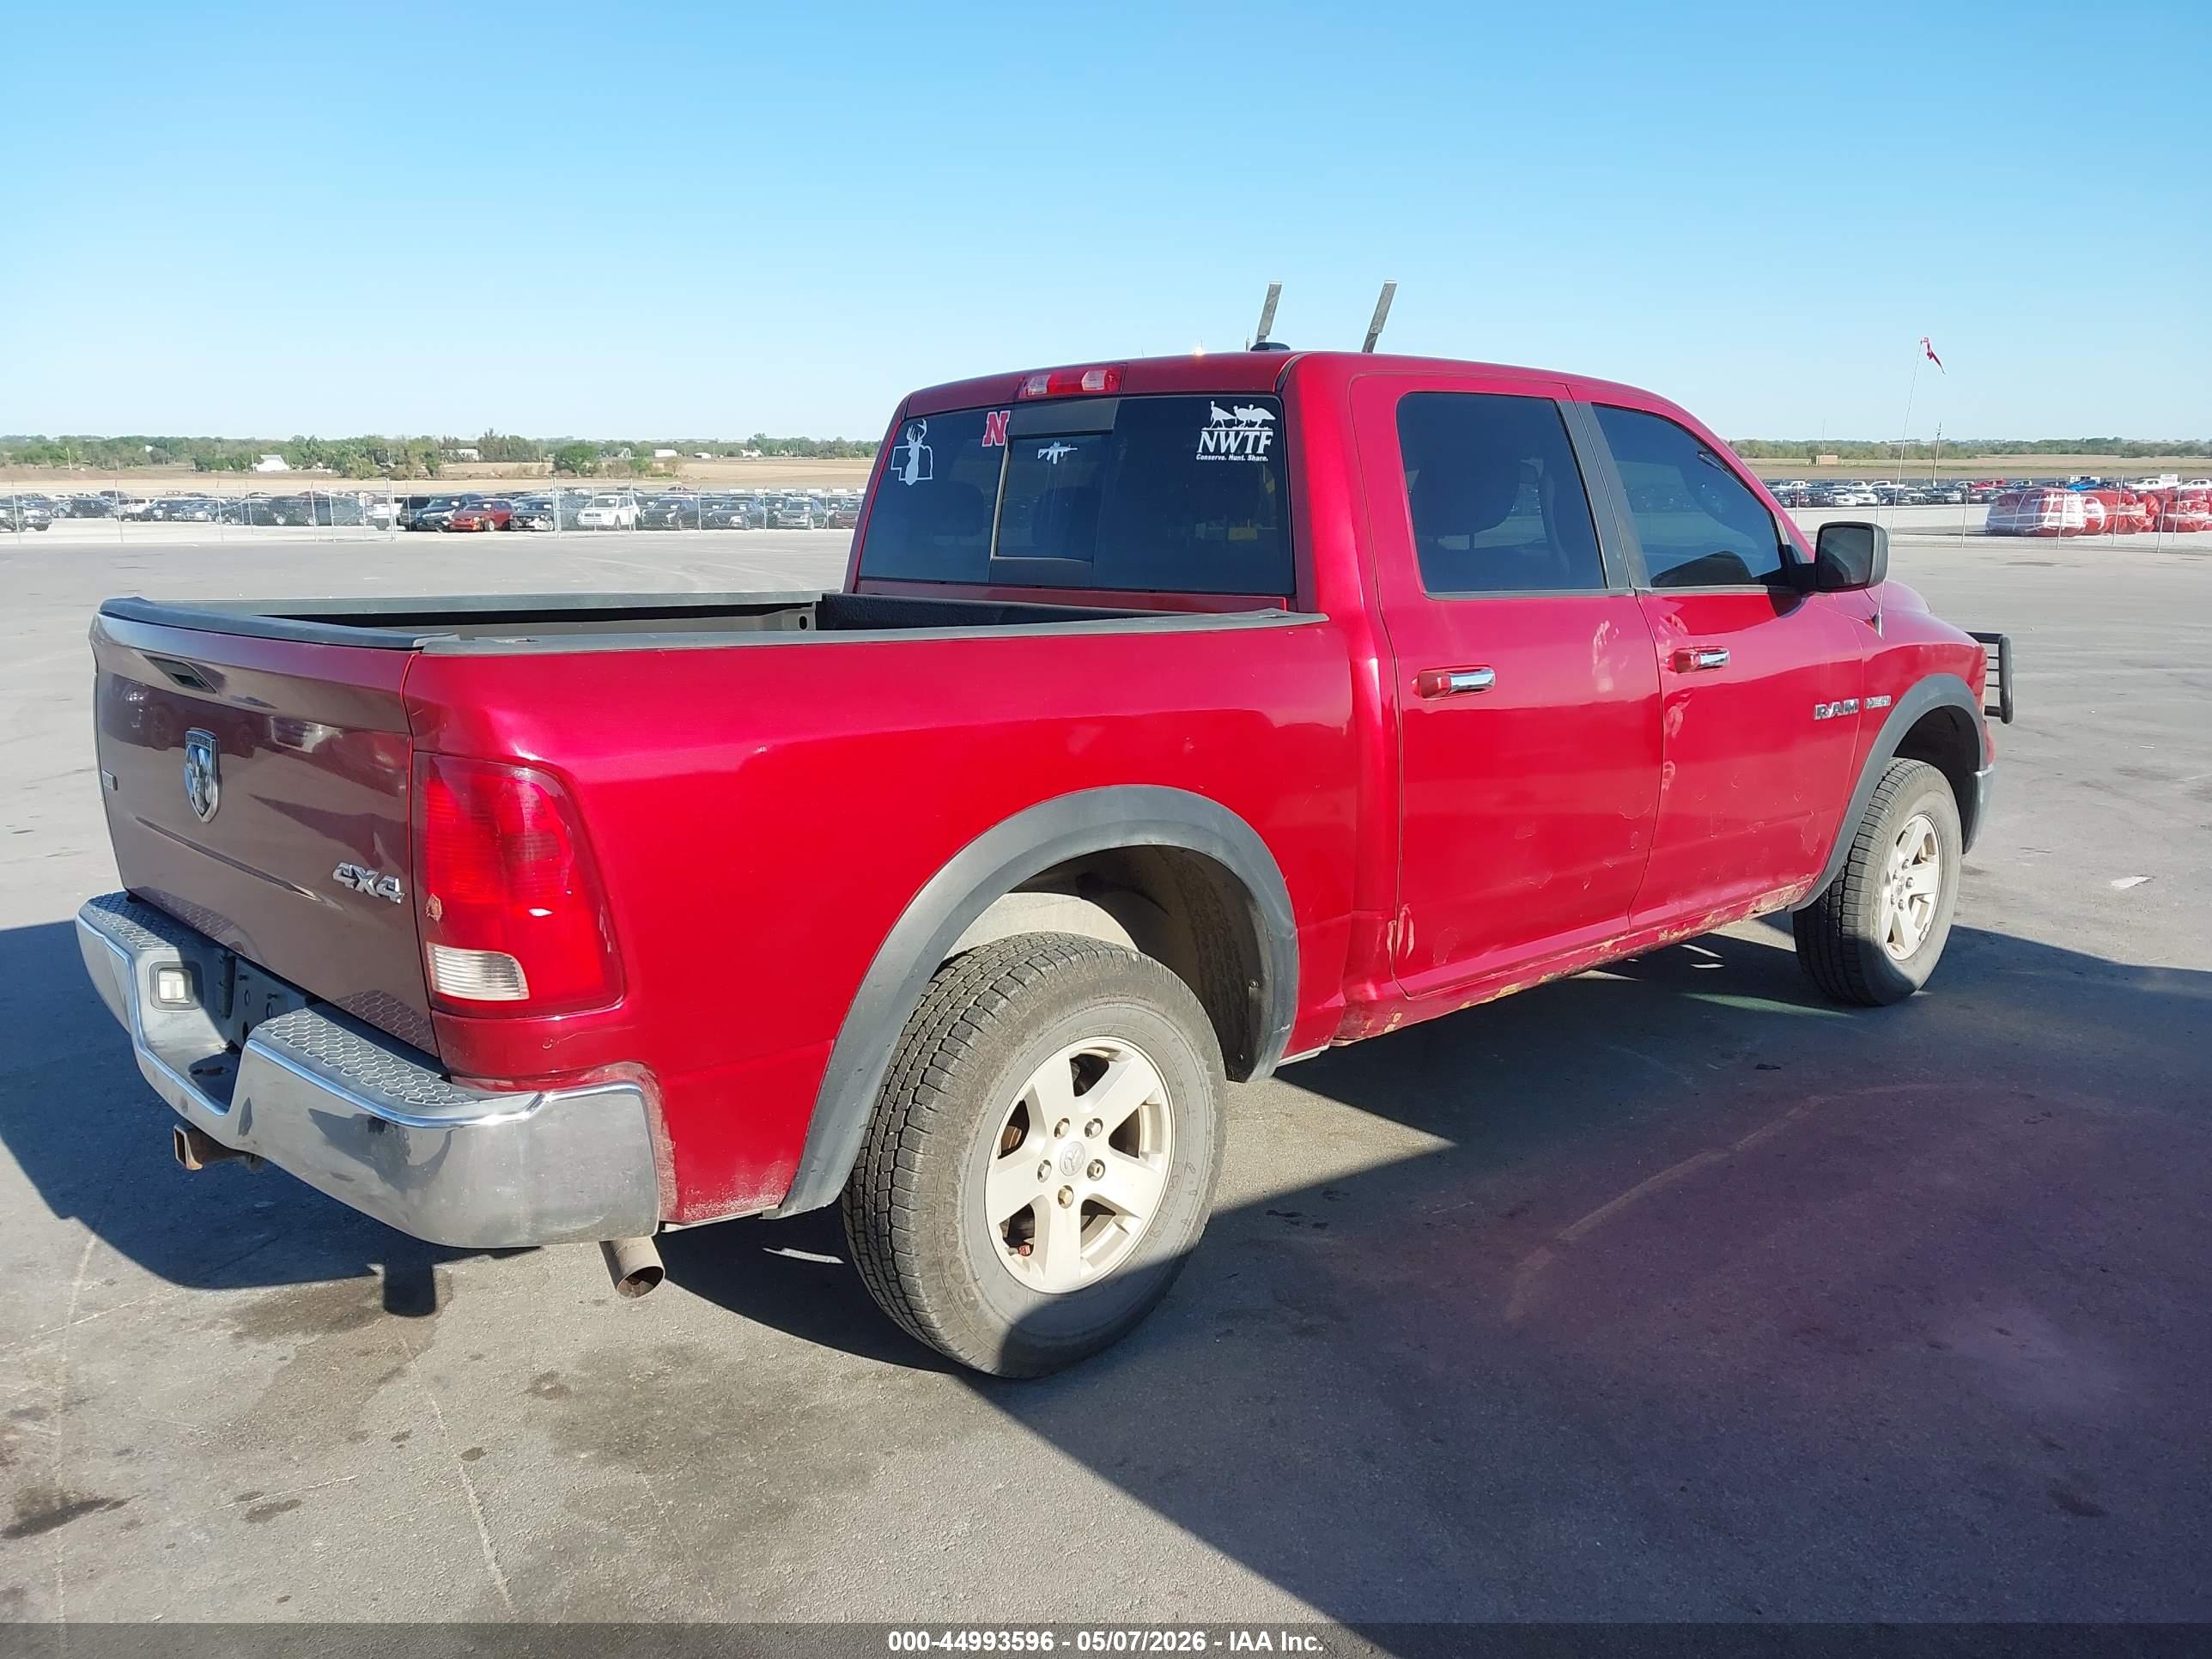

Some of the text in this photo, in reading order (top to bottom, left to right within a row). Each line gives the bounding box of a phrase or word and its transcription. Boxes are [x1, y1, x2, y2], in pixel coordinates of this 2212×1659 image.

[981, 410, 1012, 447] N
[1196, 430, 1273, 454] NWTF
[1247, 453, 1269, 462] Share.
[1814, 698, 1860, 720] RAM
[332, 861, 405, 904] 4X4
